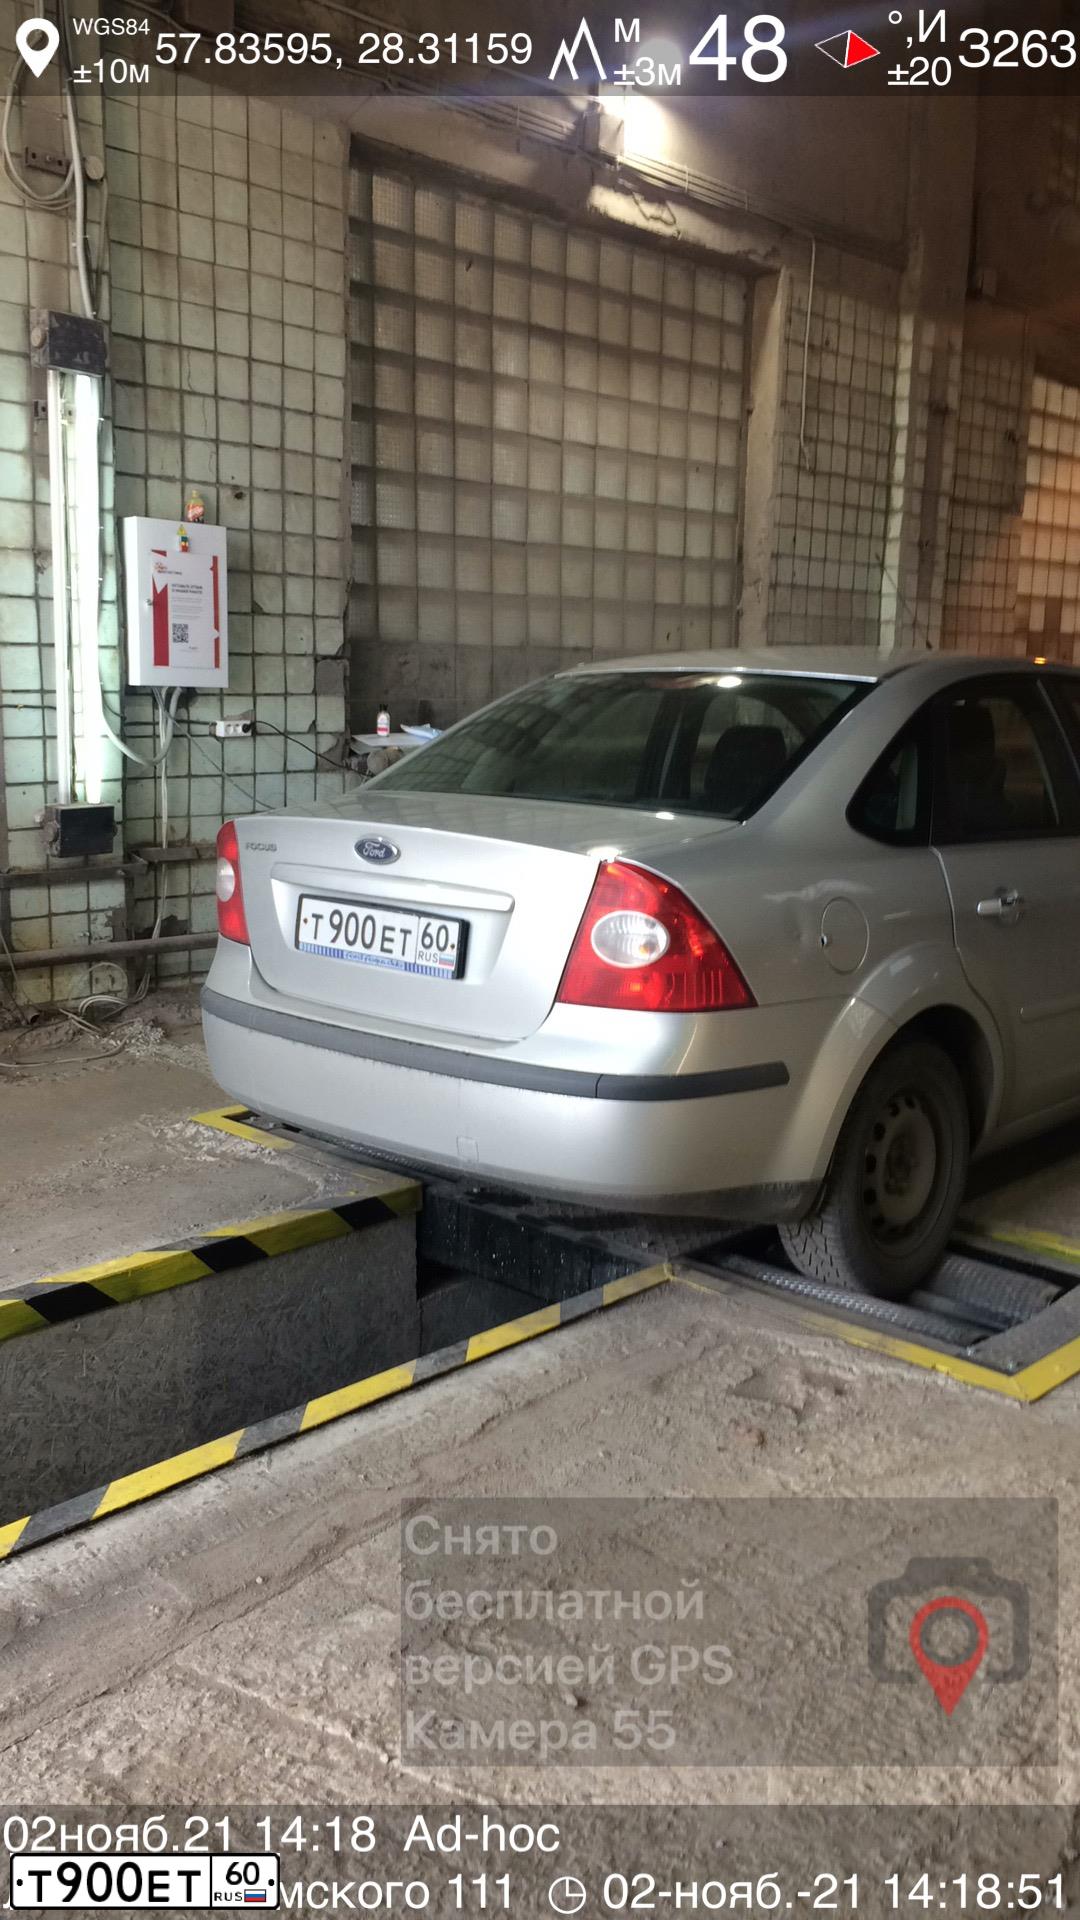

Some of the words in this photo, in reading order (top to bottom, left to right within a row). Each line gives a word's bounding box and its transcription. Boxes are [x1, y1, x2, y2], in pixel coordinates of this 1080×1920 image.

[246, 842, 278, 852] FOCUS
[421, 921, 449, 952] 60
[417, 951, 439, 963] RUS
